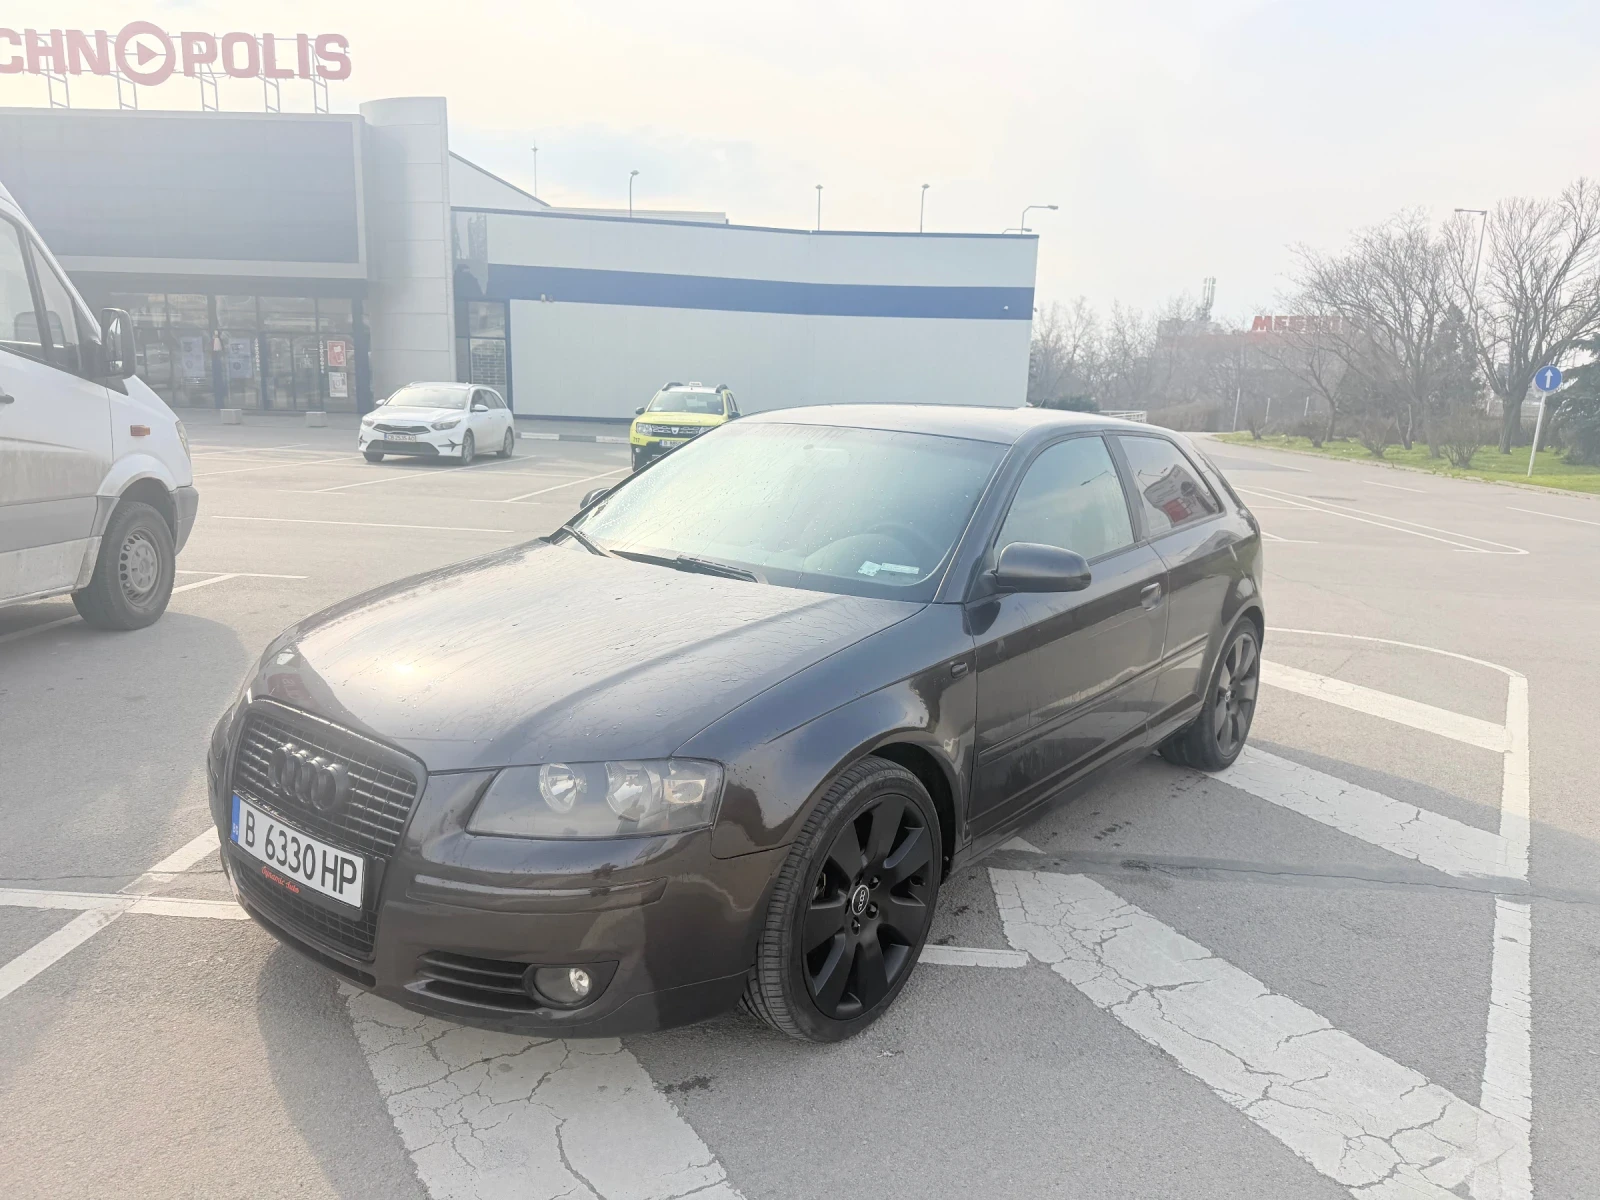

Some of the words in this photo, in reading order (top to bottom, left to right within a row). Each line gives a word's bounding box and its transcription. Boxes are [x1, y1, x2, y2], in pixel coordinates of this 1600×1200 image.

[245, 810, 255, 848] B
[265, 824, 316, 880] 6330
[321, 850, 357, 894] HP
